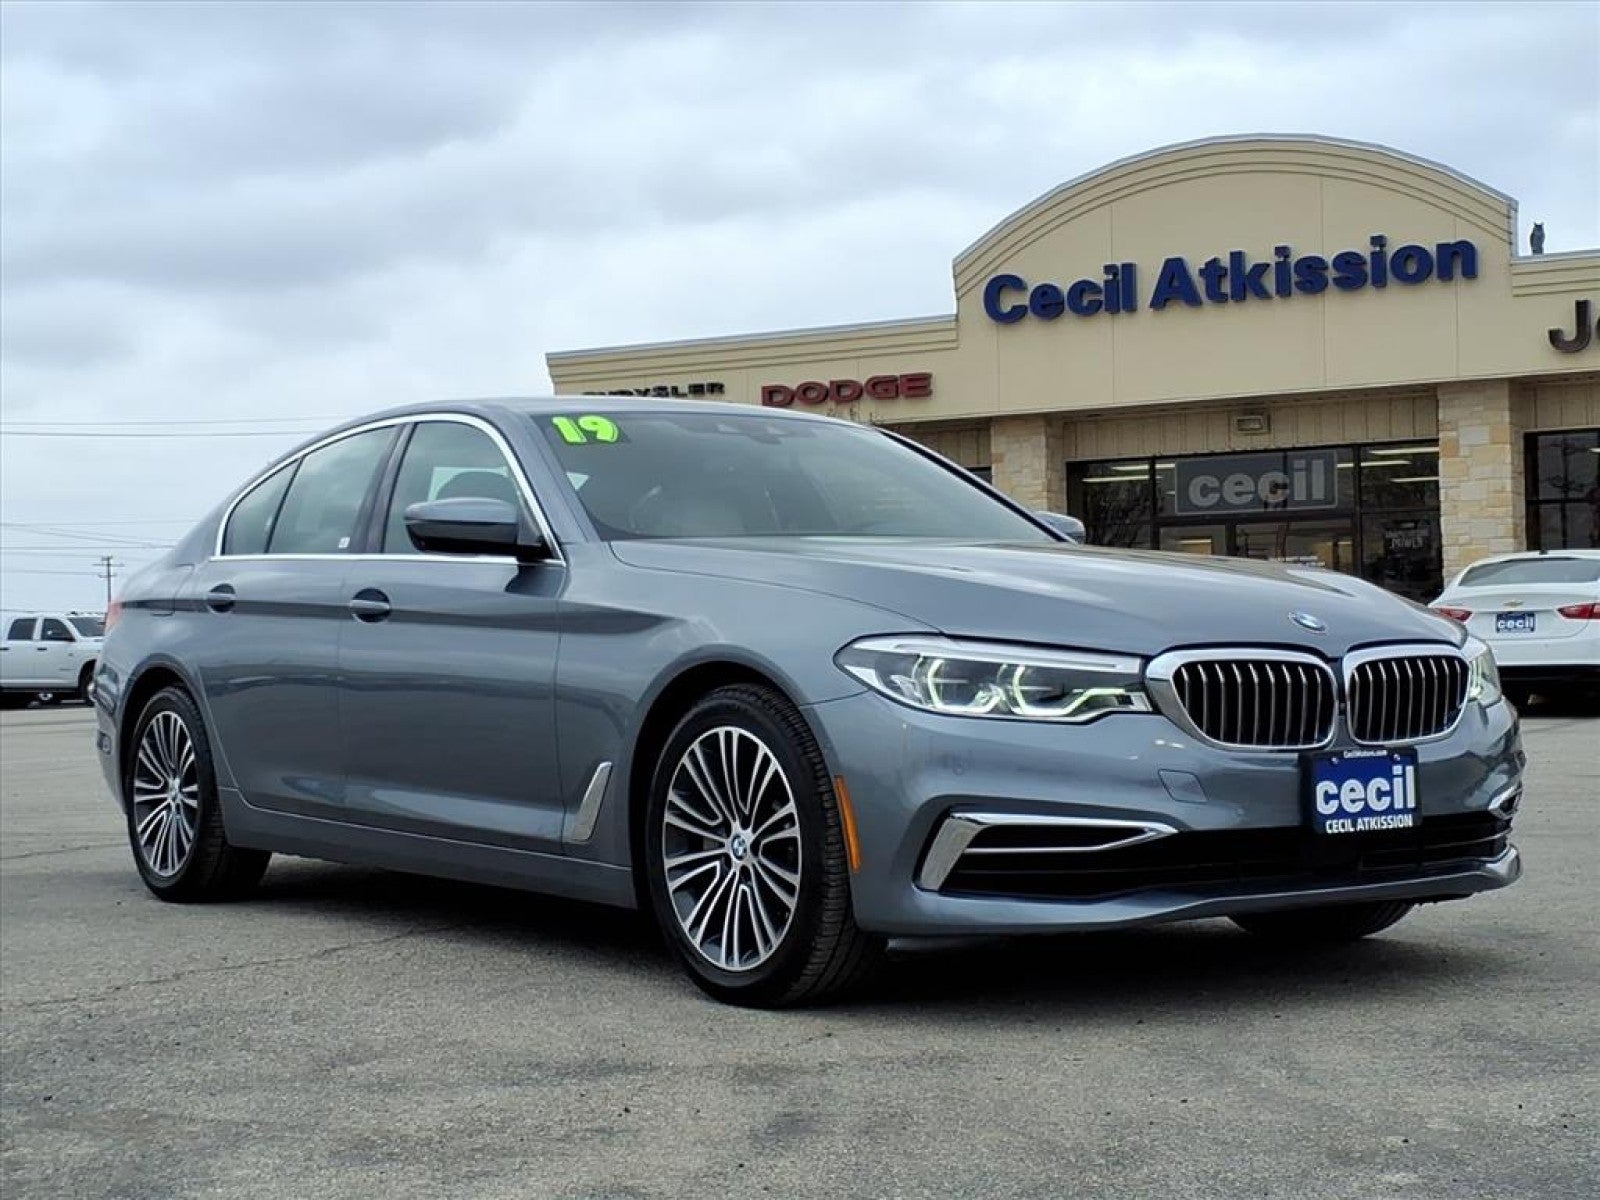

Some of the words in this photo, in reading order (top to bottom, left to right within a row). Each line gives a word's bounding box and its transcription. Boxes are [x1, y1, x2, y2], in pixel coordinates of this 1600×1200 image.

[983, 262, 1137, 324] Cecil
[1150, 235, 1477, 311] Atkission
[1548, 299, 1600, 353] J
[761, 372, 933, 407] DODGE
[552, 415, 618, 443] 19
[1188, 459, 1325, 507] cecil
[1498, 614, 1534, 629] cecil
[1316, 765, 1416, 814] cecil
[1325, 818, 1355, 834] CECIL
[1356, 814, 1413, 831] ATKISSION
